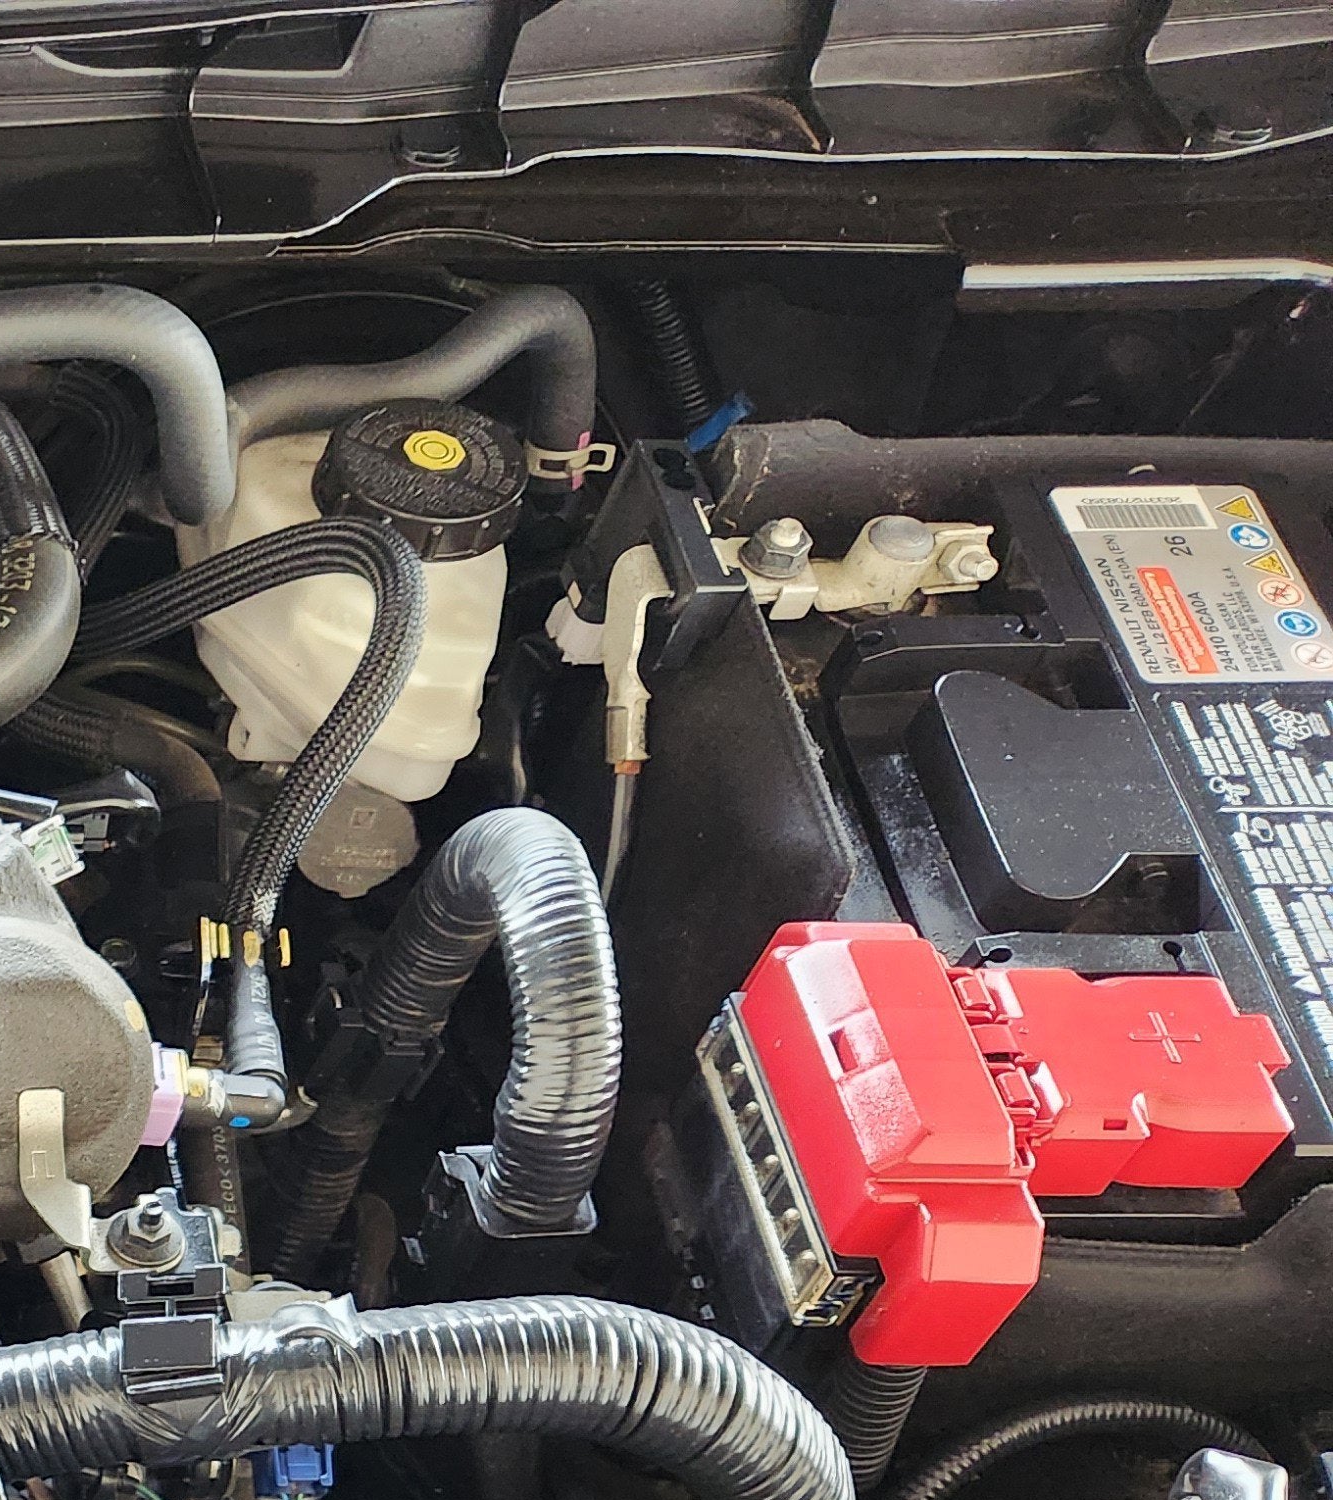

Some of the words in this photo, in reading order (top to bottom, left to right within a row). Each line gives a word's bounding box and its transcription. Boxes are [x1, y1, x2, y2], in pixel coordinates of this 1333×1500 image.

[1102, 534, 1124, 554] (EN)
[1164, 535, 1194, 556] 26
[1115, 558, 1135, 579] 510A
[1094, 558, 1132, 612] NISSAN
[1127, 582, 1149, 606] 60Ah
[1212, 602, 1239, 629] NISSAN
[1123, 617, 1164, 673] RENAULT
[1153, 633, 1168, 644] L2
[1164, 656, 1183, 673] 12V
[1207, 636, 1243, 671] 24410
